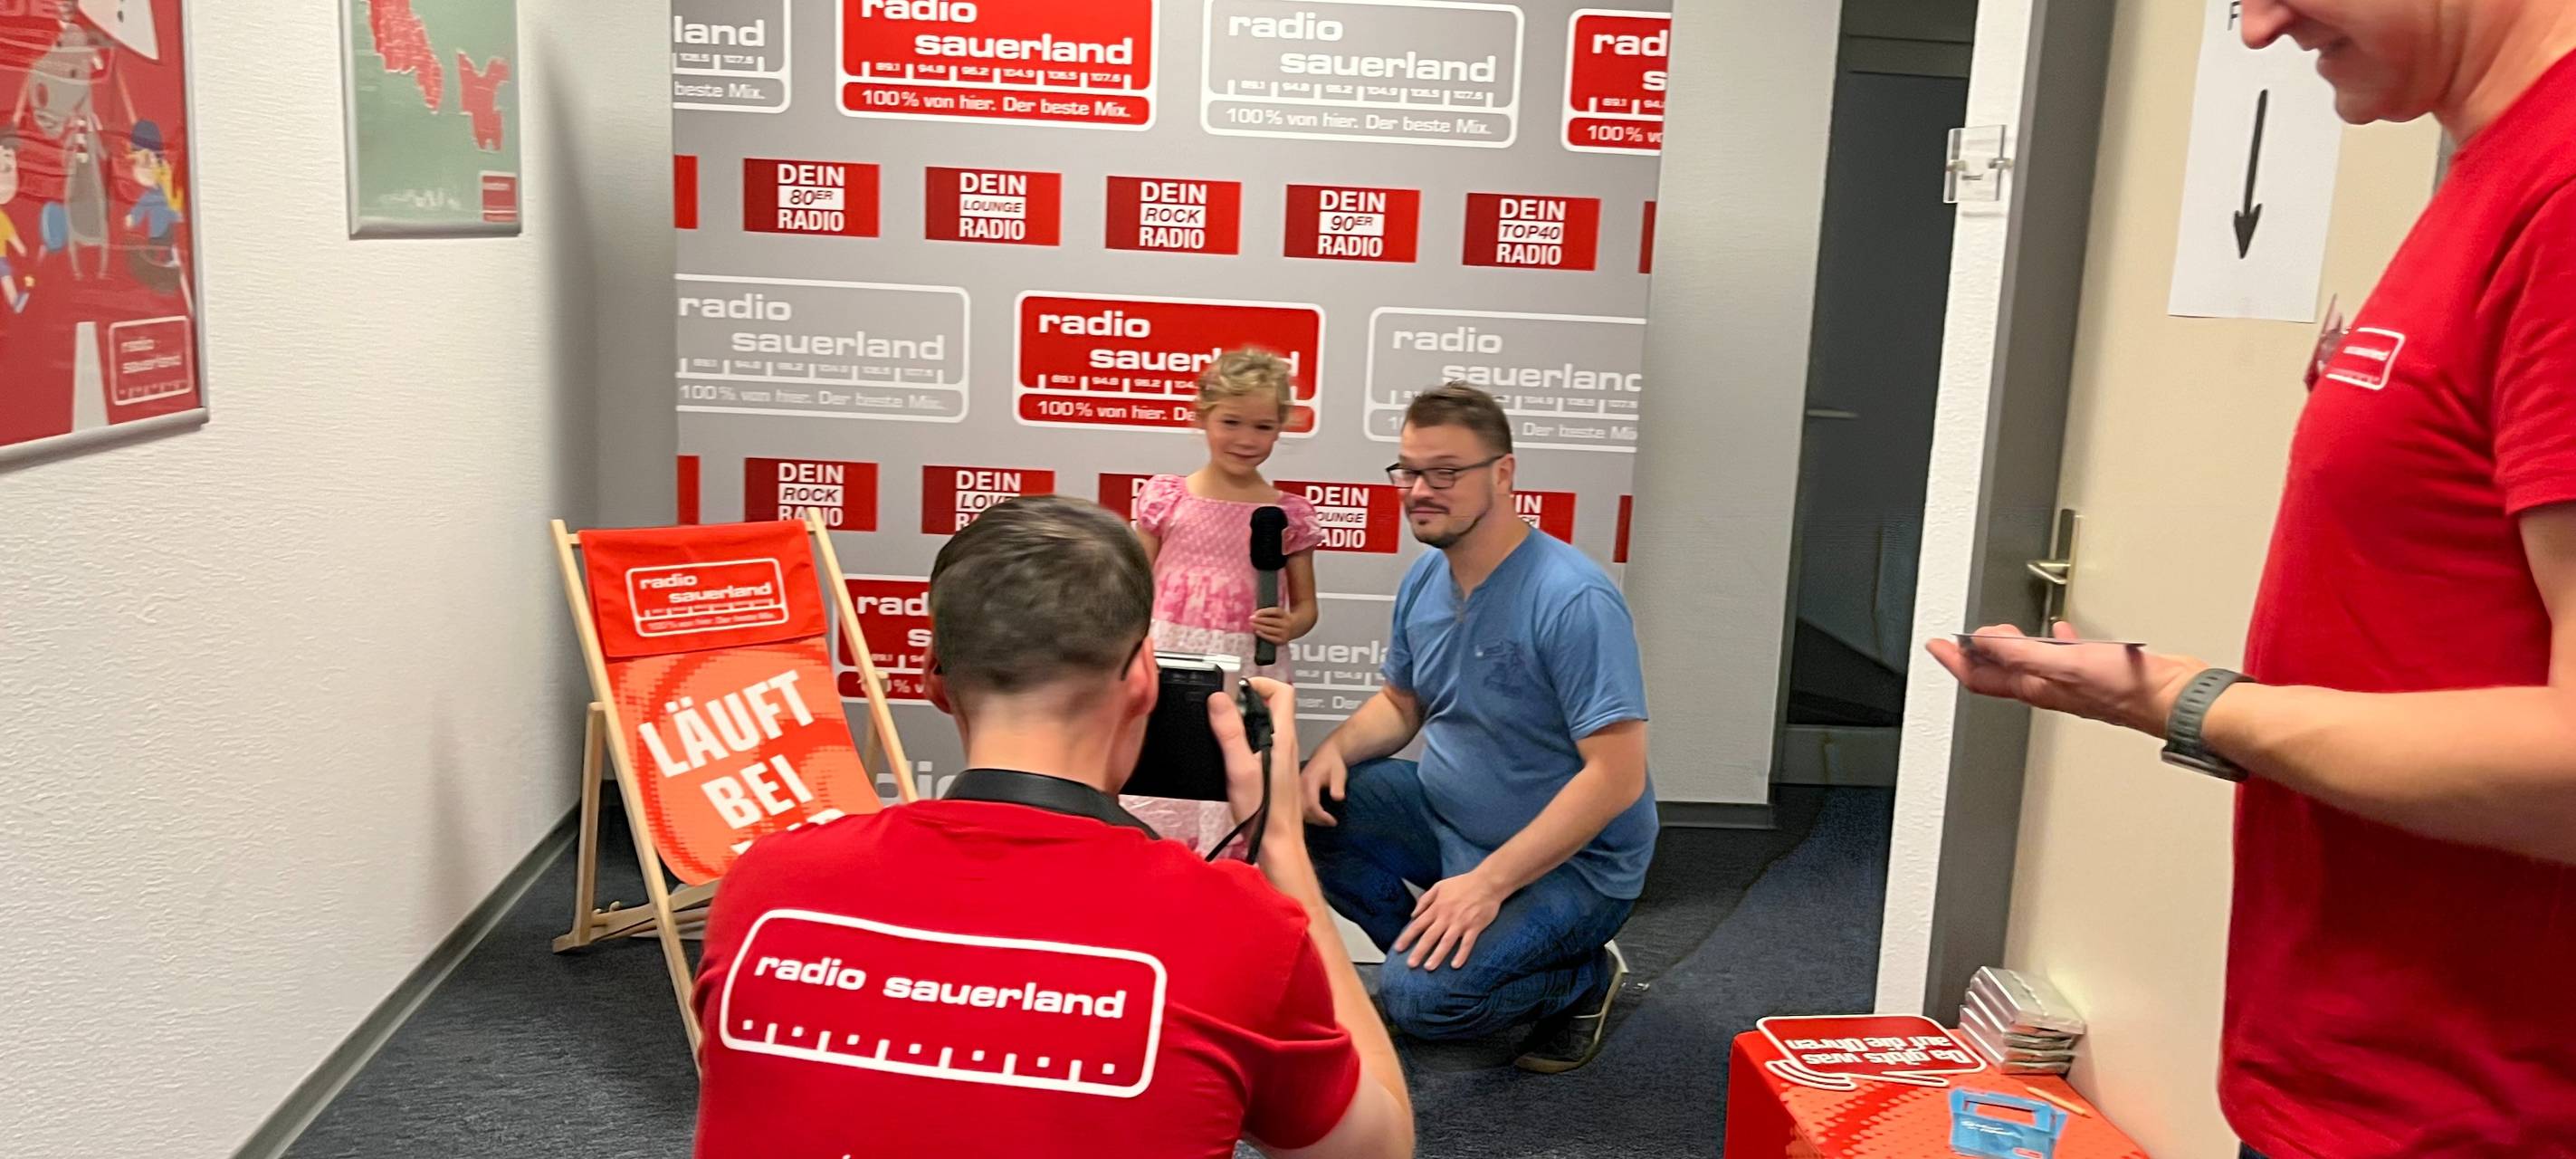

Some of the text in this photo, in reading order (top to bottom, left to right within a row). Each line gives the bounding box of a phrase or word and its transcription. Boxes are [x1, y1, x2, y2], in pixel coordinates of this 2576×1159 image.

[862, 0, 978, 24] radio
[1228, 11, 1343, 42] radio
[914, 33, 1133, 65] sauerland
[1280, 51, 1496, 82] sauerland
[923, 95, 955, 110] von
[959, 93, 997, 111] hier.
[1002, 96, 1036, 113] Der
[1040, 98, 1090, 116] beste
[1286, 114, 1318, 127] von
[1365, 113, 1398, 130] Der
[1402, 115, 1451, 133] beste
[777, 163, 845, 187] DEIN
[959, 171, 1027, 196] DEIN
[788, 188, 835, 206] 80ER
[1140, 180, 1207, 205] DEIN
[1319, 189, 1387, 214] DEIN
[962, 198, 1023, 214] LOUNGE
[1143, 206, 1202, 225] ROCK
[1499, 197, 1567, 221] DEIN
[777, 208, 845, 233] RADIO
[959, 217, 1026, 241] RADIO
[1329, 215, 1375, 233] 90ER
[1139, 226, 1206, 250] RADIO
[1501, 224, 1561, 241] TOP40
[1317, 235, 1384, 258] RADIO
[1495, 243, 1563, 266] RADIO
[679, 292, 793, 321] radio
[1038, 310, 1151, 339] radio
[730, 330, 946, 361] sauerland
[1391, 326, 1503, 354] radio
[1097, 407, 1128, 418] von
[1173, 407, 1197, 422] De
[1522, 422, 1555, 437] Der
[778, 462, 844, 484] DEIN
[956, 470, 1021, 492] DEIN
[781, 486, 839, 503] ROCK
[1305, 485, 1369, 507] DEIN
[1316, 511, 1364, 524] OUNGE
[1316, 527, 1366, 549] ADIO
[639, 572, 699, 590] radio
[668, 581, 774, 604] sauerland
[638, 669, 815, 779] LÄUFT
[701, 753, 814, 830] BEI
[754, 956, 1127, 1020] radio sauerland
[1785, 1036, 1953, 1052] auf die Ohren
[1800, 1051, 1863, 1065] was
